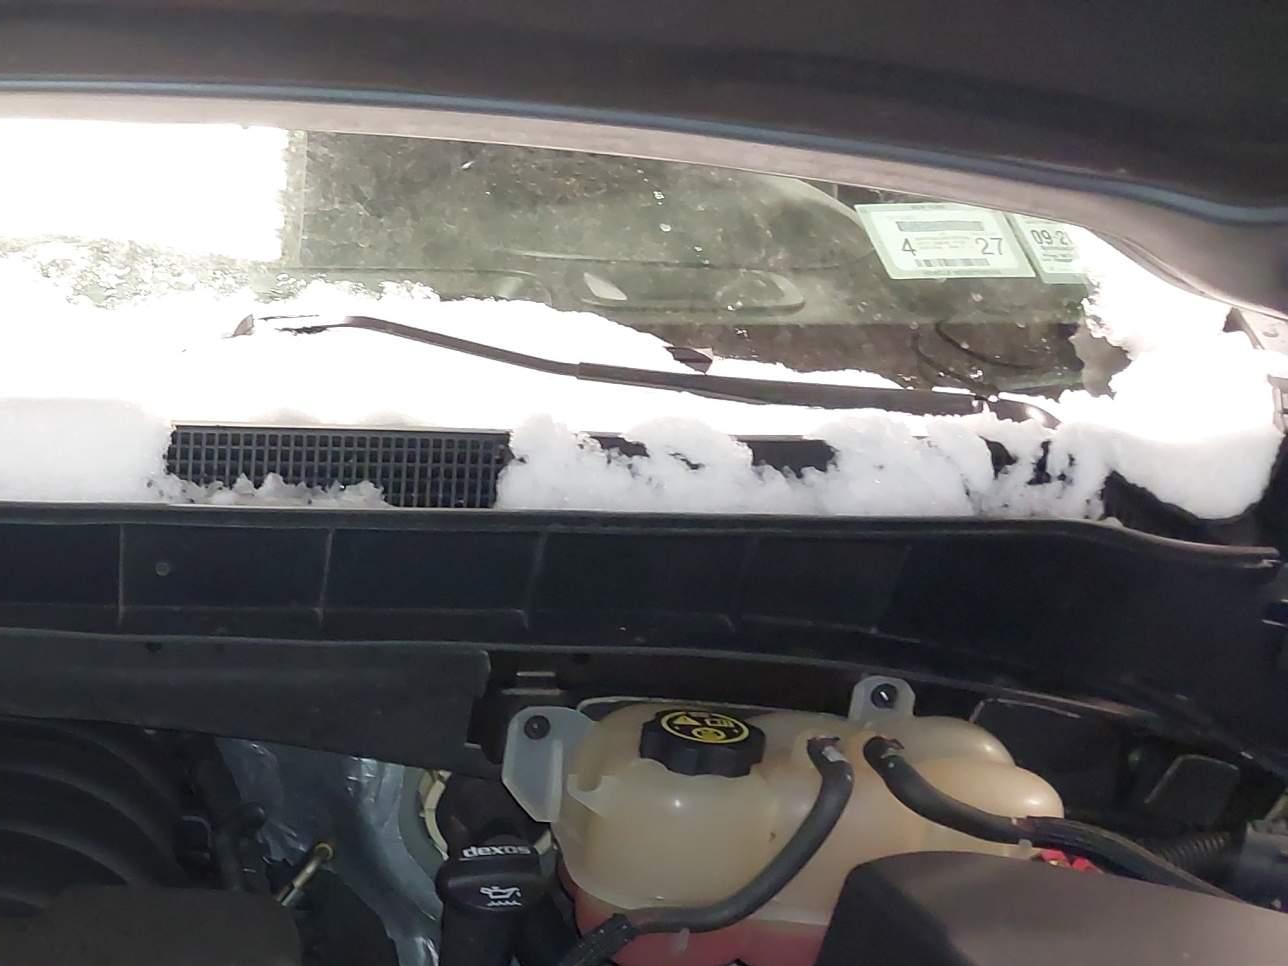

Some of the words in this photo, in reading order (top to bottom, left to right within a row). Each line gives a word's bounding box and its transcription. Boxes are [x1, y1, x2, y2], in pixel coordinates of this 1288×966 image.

[901, 237, 917, 257] 4
[975, 237, 1004, 256] 27
[462, 845, 531, 858] dexos
